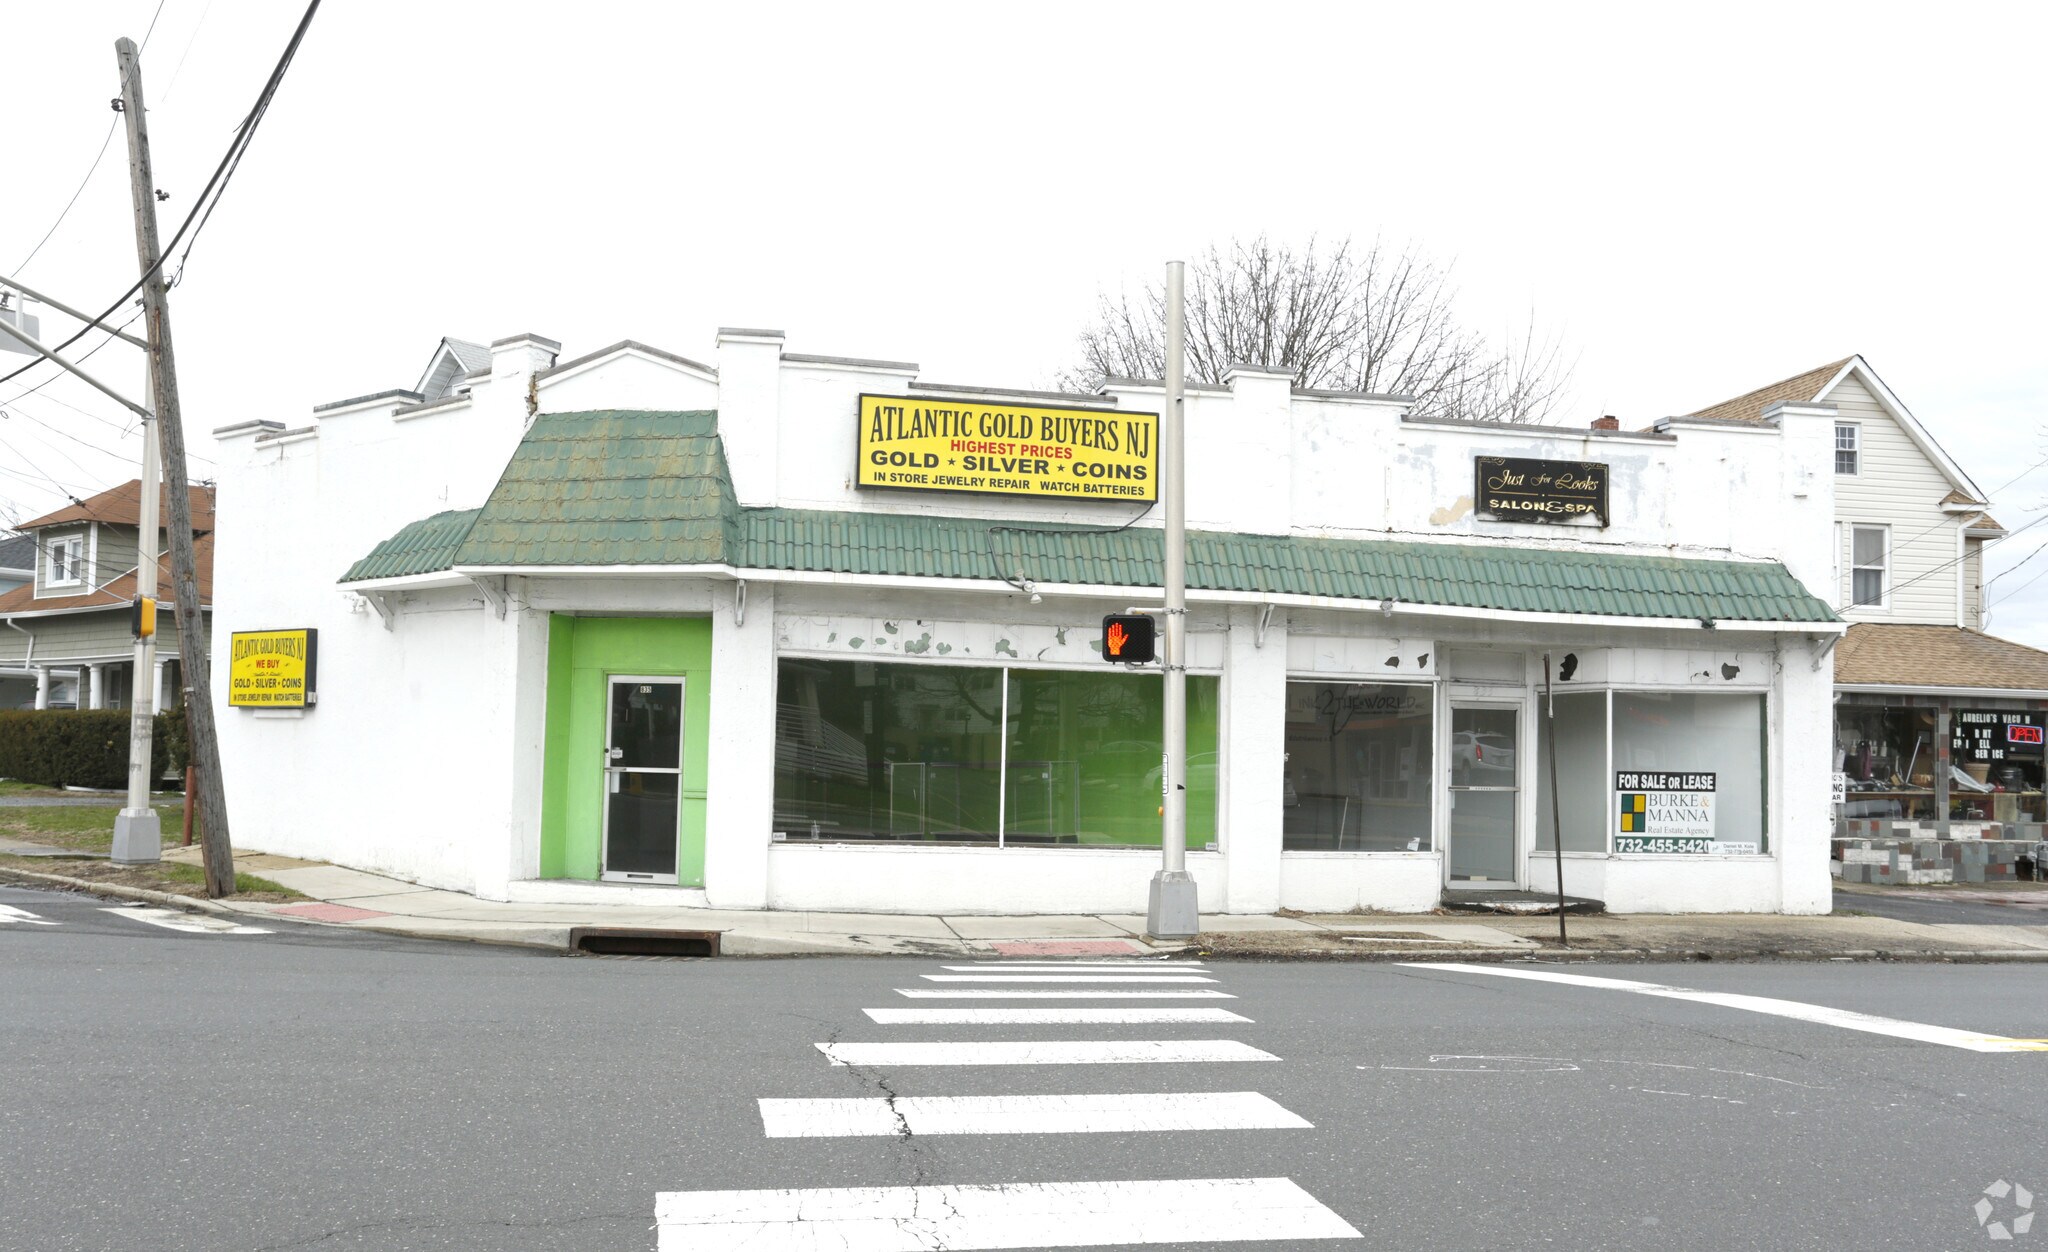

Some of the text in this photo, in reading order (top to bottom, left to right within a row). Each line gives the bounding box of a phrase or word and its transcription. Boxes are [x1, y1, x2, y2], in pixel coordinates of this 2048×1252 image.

[870, 405, 1149, 459] ATLANTIC GOLD BUYERS NJ
[951, 439, 1073, 459] HIGHEST PRICES
[871, 450, 1147, 480] GOLD SILVER COINS
[874, 472, 1145, 495] IN STORE JEWELRY REPAIR WATCH BATTERIES
[1488, 469, 1599, 491] Just for Looks
[1489, 499, 1545, 511] SALON
[233, 637, 304, 662] ATLANTIC GOLD BUYERS NJ
[256, 660, 280, 668] WE BUY
[234, 678, 301, 688] GOLD SILVER COINS
[1962, 713, 1998, 723] AURELIO'S
[2010, 727, 2041, 742] OPEN
[1619, 774, 1638, 788] FOR
[1641, 775, 1666, 789] SALE
[1683, 775, 1714, 790] LEASE
[1649, 794, 1710, 807] BURKE &
[1648, 809, 1709, 822] MANNA
[1647, 826, 1709, 836] Real Estate Agency
